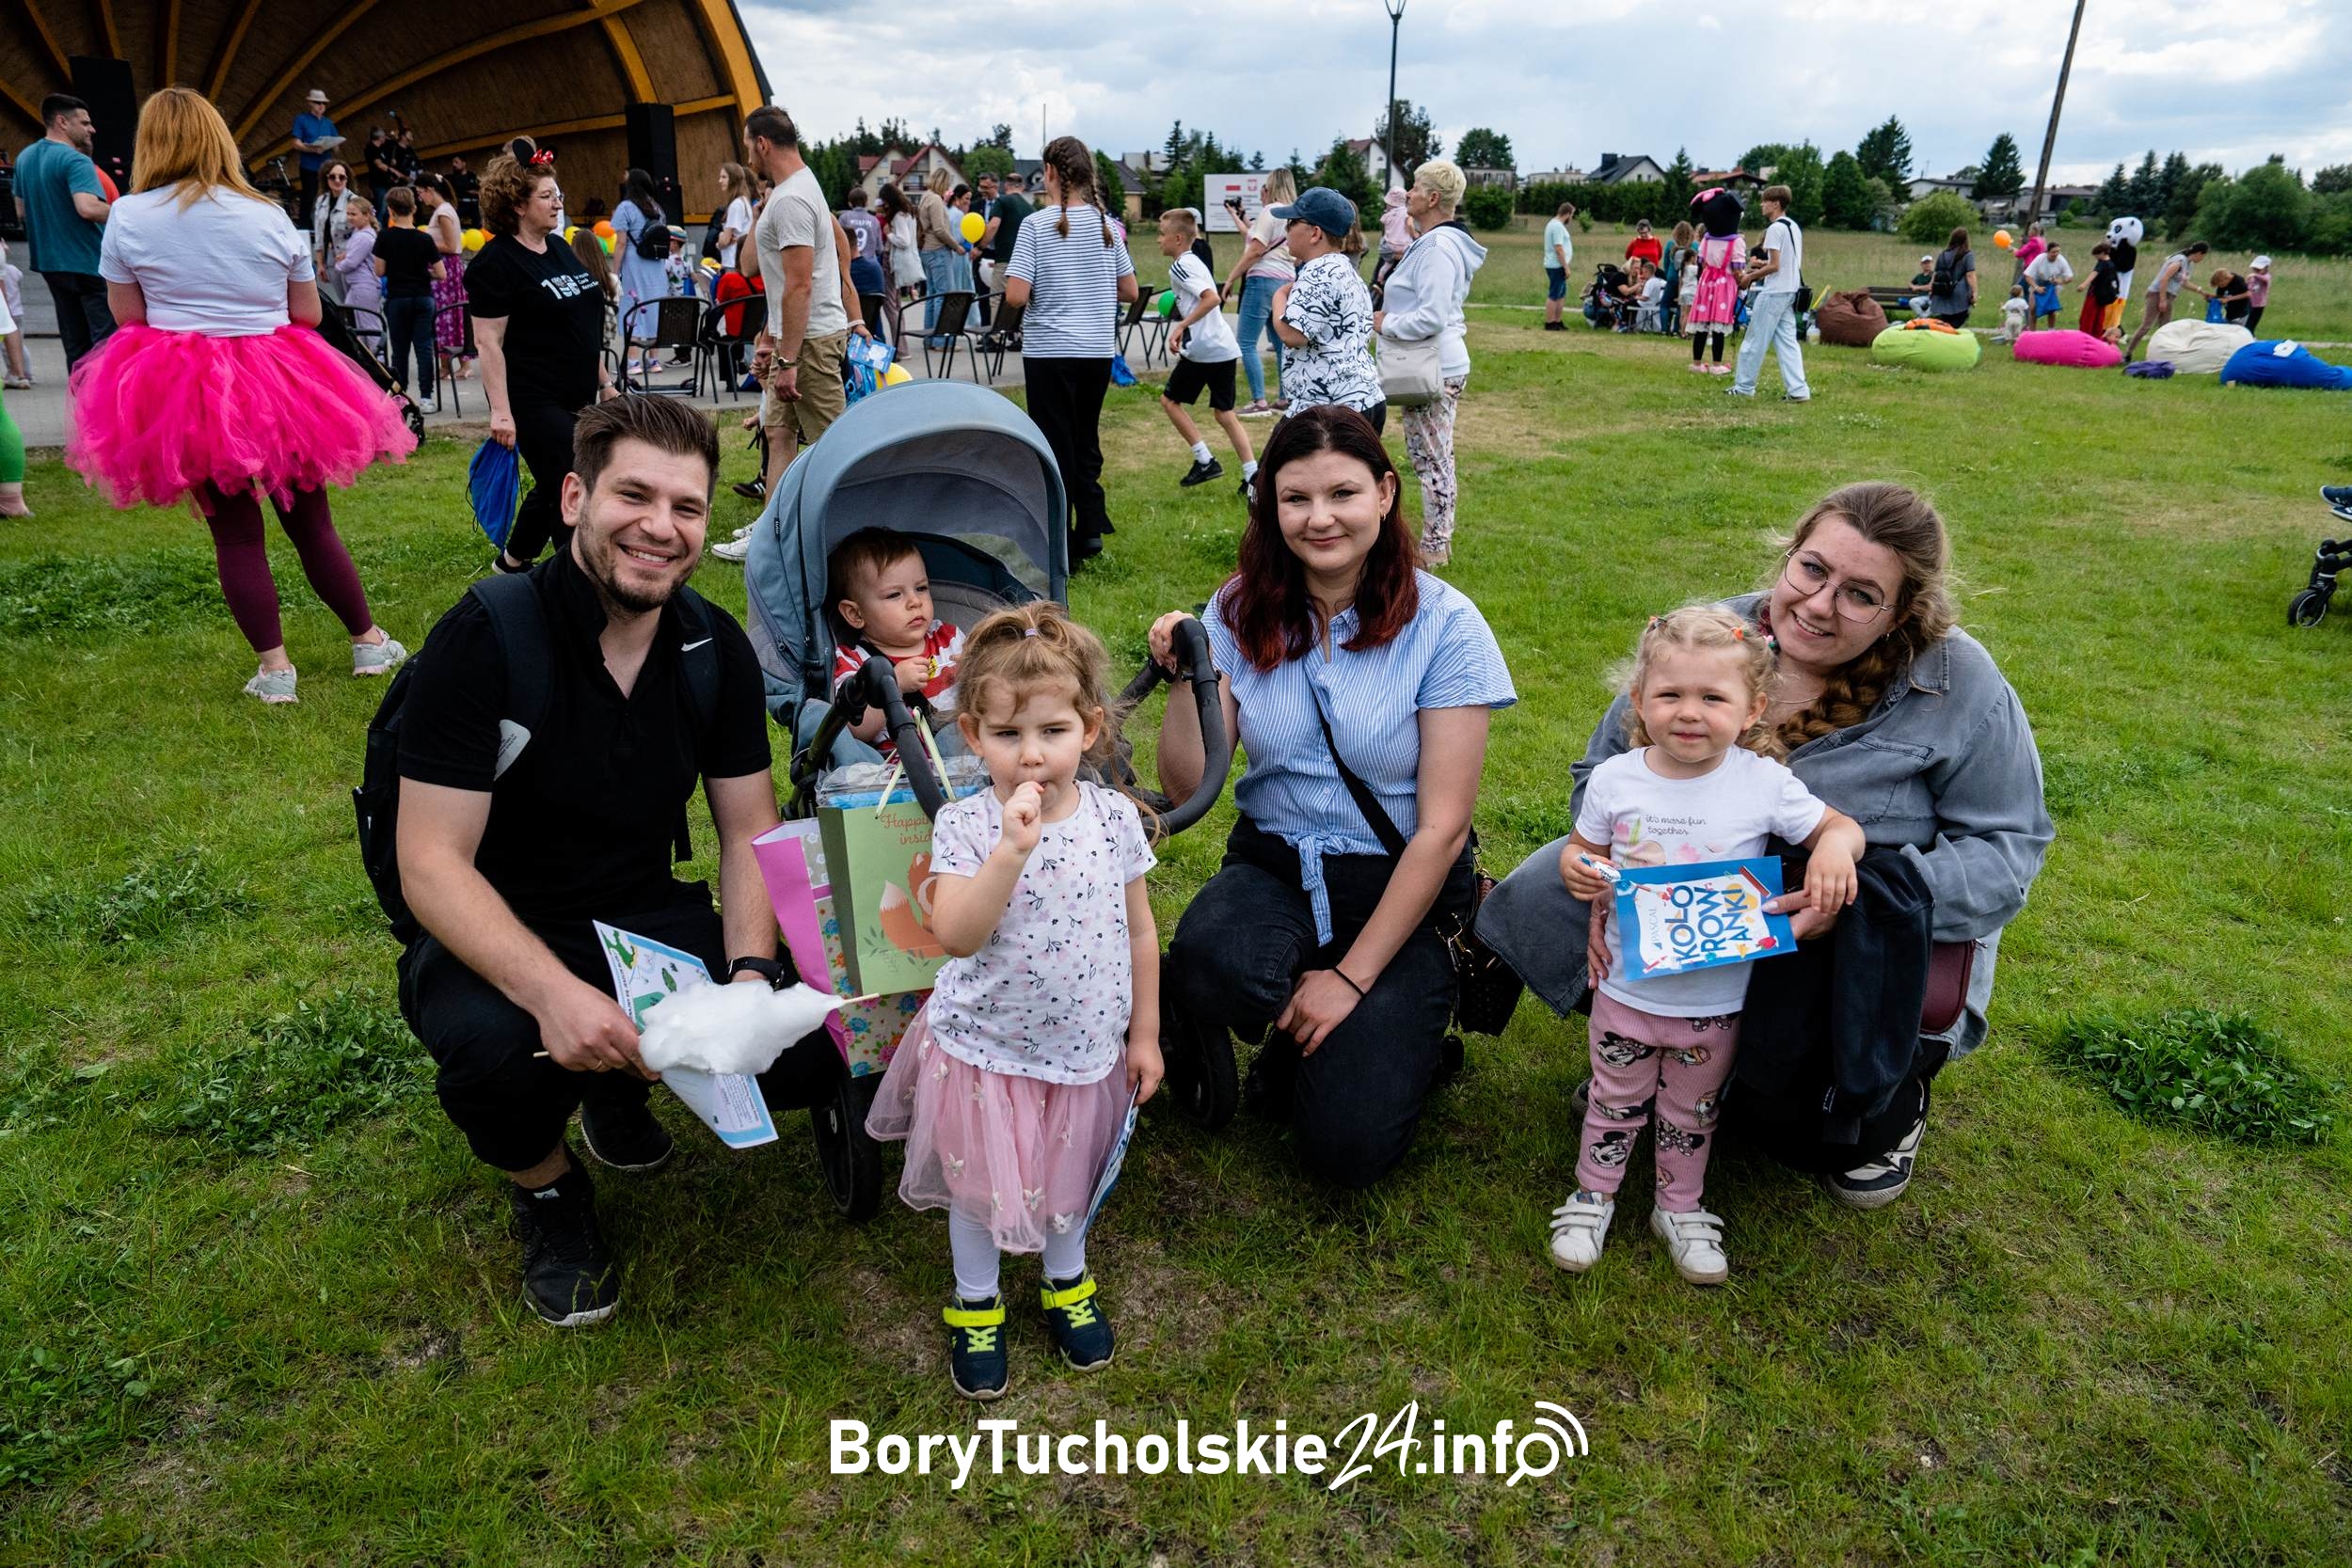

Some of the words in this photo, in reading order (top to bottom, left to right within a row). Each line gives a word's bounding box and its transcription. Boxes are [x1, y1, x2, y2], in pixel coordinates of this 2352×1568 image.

[899, 828, 933, 845] insid
[1647, 826, 1690, 836] together
[1688, 816, 1707, 826] fun
[1664, 885, 1700, 962] KOLO
[1693, 886, 1727, 953] ROW
[1721, 888, 1753, 942] ANKI
